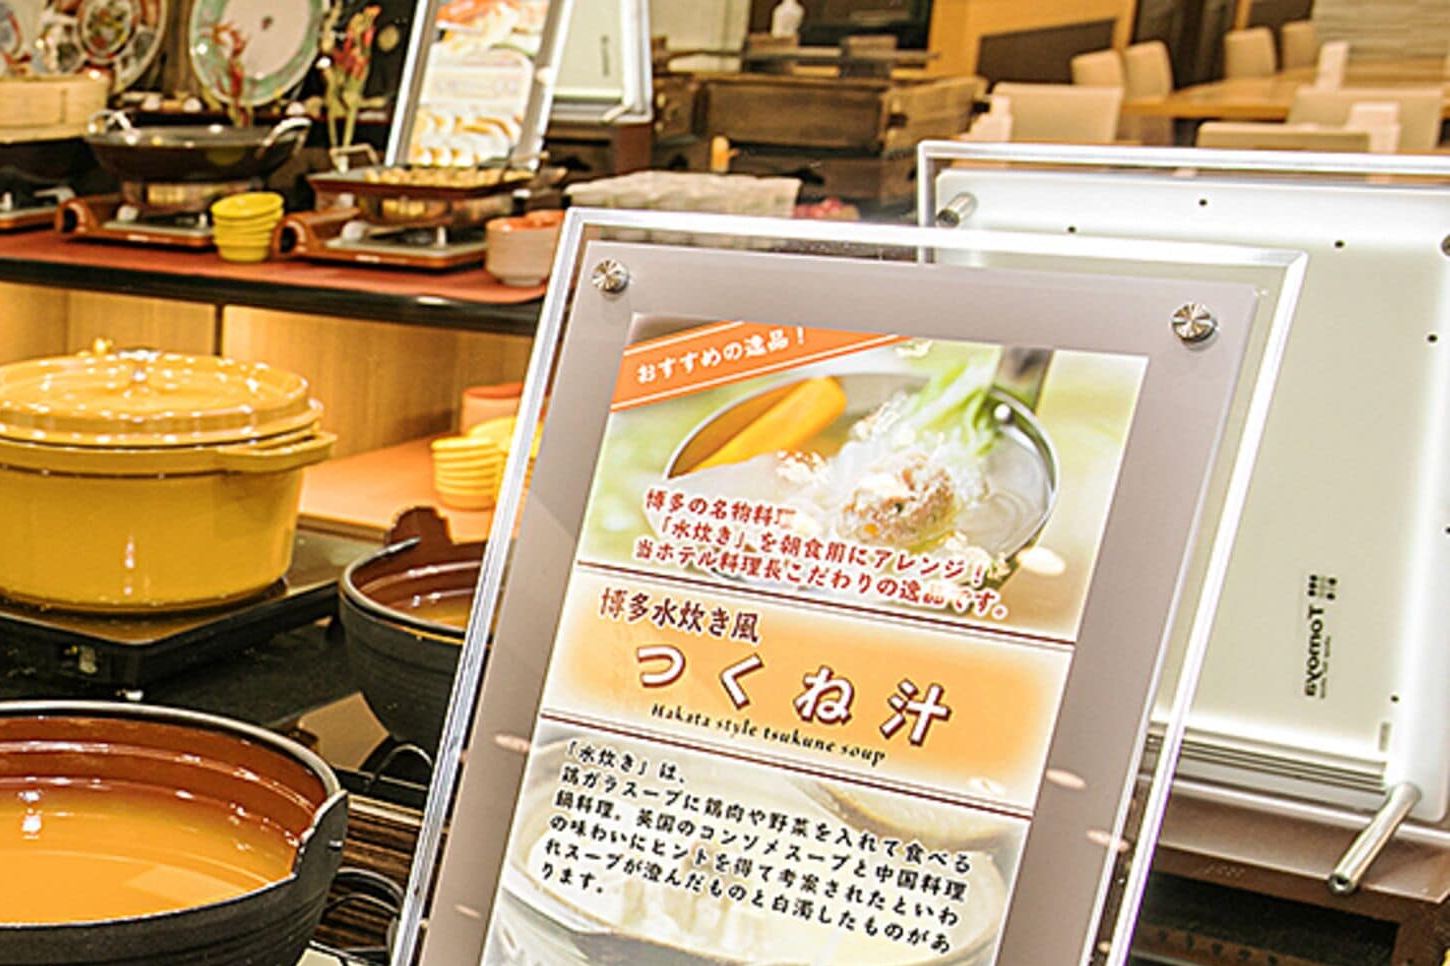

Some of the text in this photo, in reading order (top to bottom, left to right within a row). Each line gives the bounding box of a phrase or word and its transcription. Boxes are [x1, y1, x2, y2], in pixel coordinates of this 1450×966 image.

[599, 588, 761, 642] 博多水炊き風
[636, 645, 953, 748] つくね汁
[568, 741, 685, 784] 「水炊き」は、
[651, 703, 886, 768] Hakata style tsukune soup
[541, 862, 603, 894] ります。
